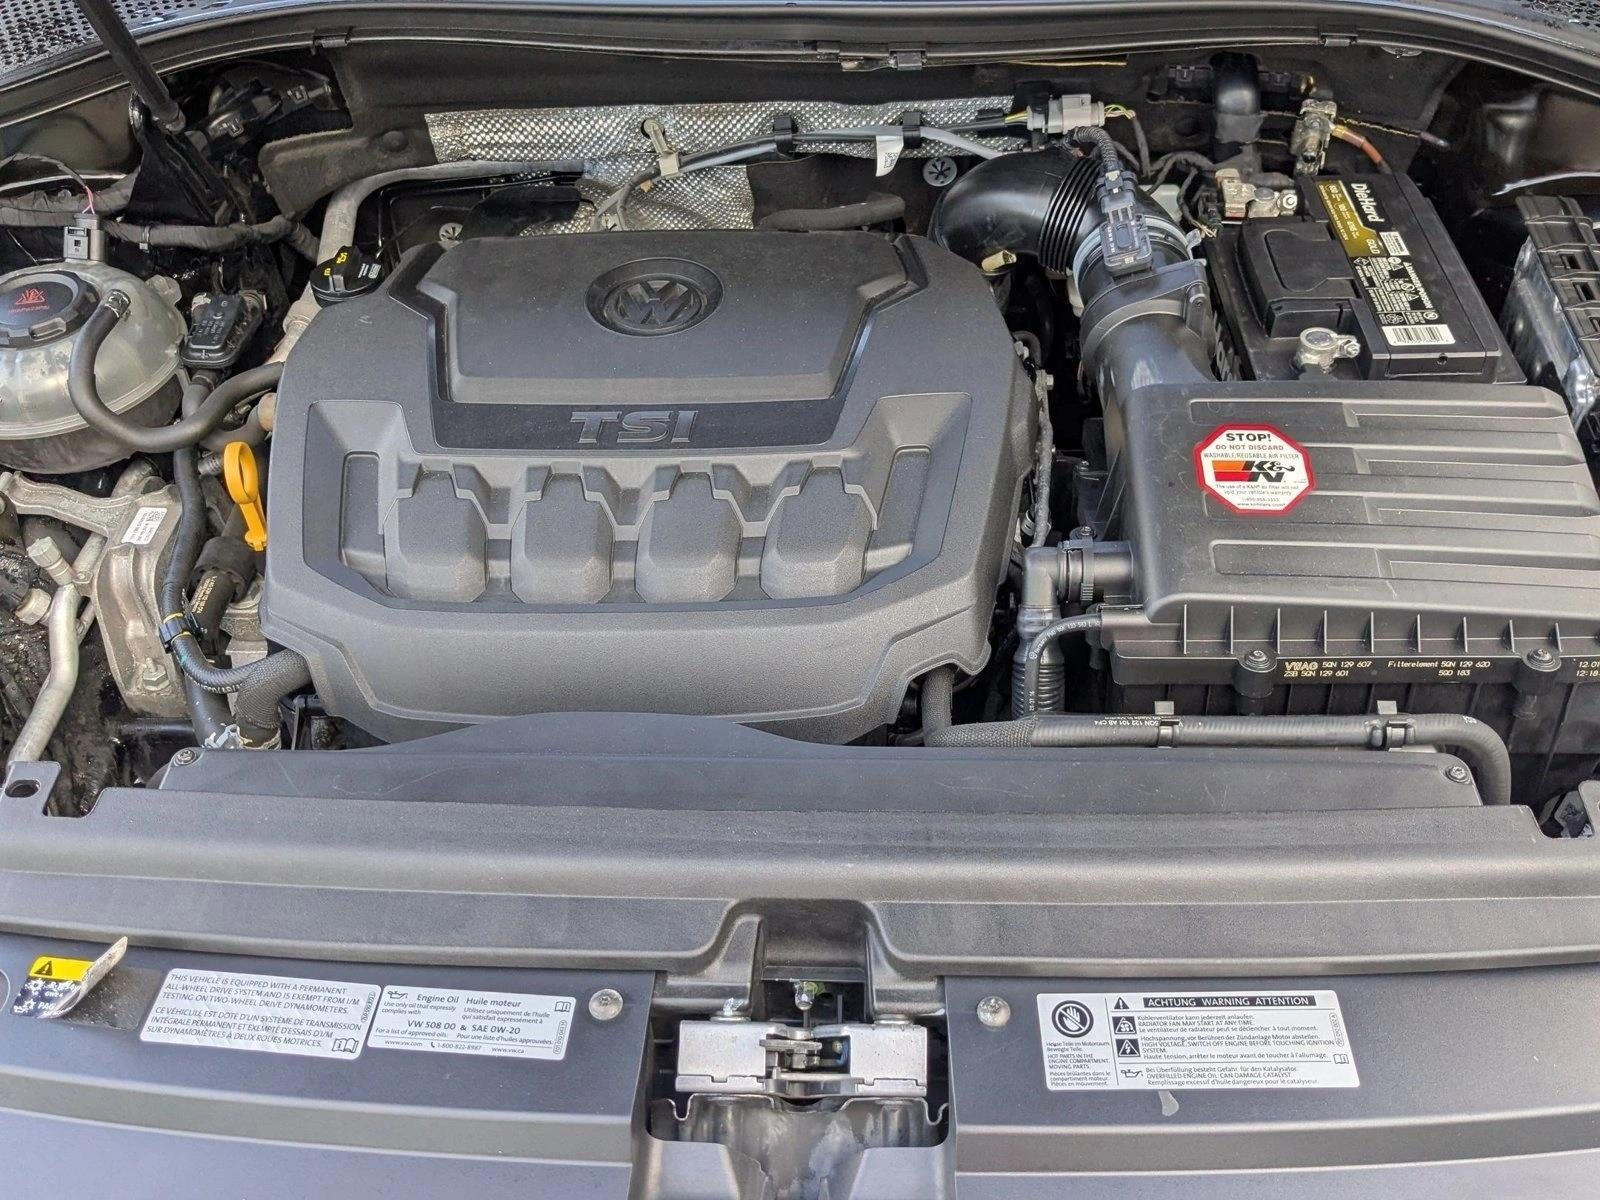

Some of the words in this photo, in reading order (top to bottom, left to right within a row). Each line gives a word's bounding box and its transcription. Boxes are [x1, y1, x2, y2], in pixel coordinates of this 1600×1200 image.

[1351, 183, 1385, 222] DieHard
[1366, 238, 1380, 254] GOLD
[1405, 266, 1421, 287] DANGER
[1417, 287, 1433, 308] POISON
[571, 410, 698, 443] TSI
[1226, 433, 1271, 442] STOP!
[165, 983, 208, 992] ALL-WHEEL
[210, 986, 232, 994] DRIVE
[263, 990, 282, 998] AND
[292, 994, 322, 1002] EXEMPT
[323, 996, 345, 1004] FROM
[189, 976, 219, 984] VEHICLE
[230, 979, 268, 988] EQUIPPED
[299, 984, 348, 994] PERMANENT
[162, 992, 194, 1000] TESTING
[210, 995, 256, 1006] TWO-WHEEL
[258, 1000, 281, 1008] DRIVE
[284, 1002, 348, 1014] DYNAMOMETERS.
[417, 994, 445, 1003] Engine
[466, 997, 488, 1006] Huile
[1148, 998, 1197, 1006] ACHTUNG
[1202, 998, 1250, 1006] WARNING
[1256, 997, 1308, 1006] ATTENTION
[166, 1007, 202, 1018] VÉHICULE
[240, 1013, 260, 1021] D'UN
[260, 1014, 292, 1024] SYSTÈME
[306, 1019, 362, 1031] TRANSMISSION
[192, 1018, 236, 1029] PERMANENT
[281, 1026, 312, 1036] D'ESSAIS
[408, 1020, 424, 1028] VW
[425, 1022, 442, 1030] 508
[444, 1022, 456, 1030] 00
[472, 1024, 488, 1032] SAE
[490, 1026, 520, 1034] 0W-20
[164, 1026, 226, 1038] DYNAMOMÈTRES
[234, 1032, 255, 1040] DEUX
[258, 1035, 282, 1044] ROUES
[283, 1037, 322, 1047] MOTRICES.
